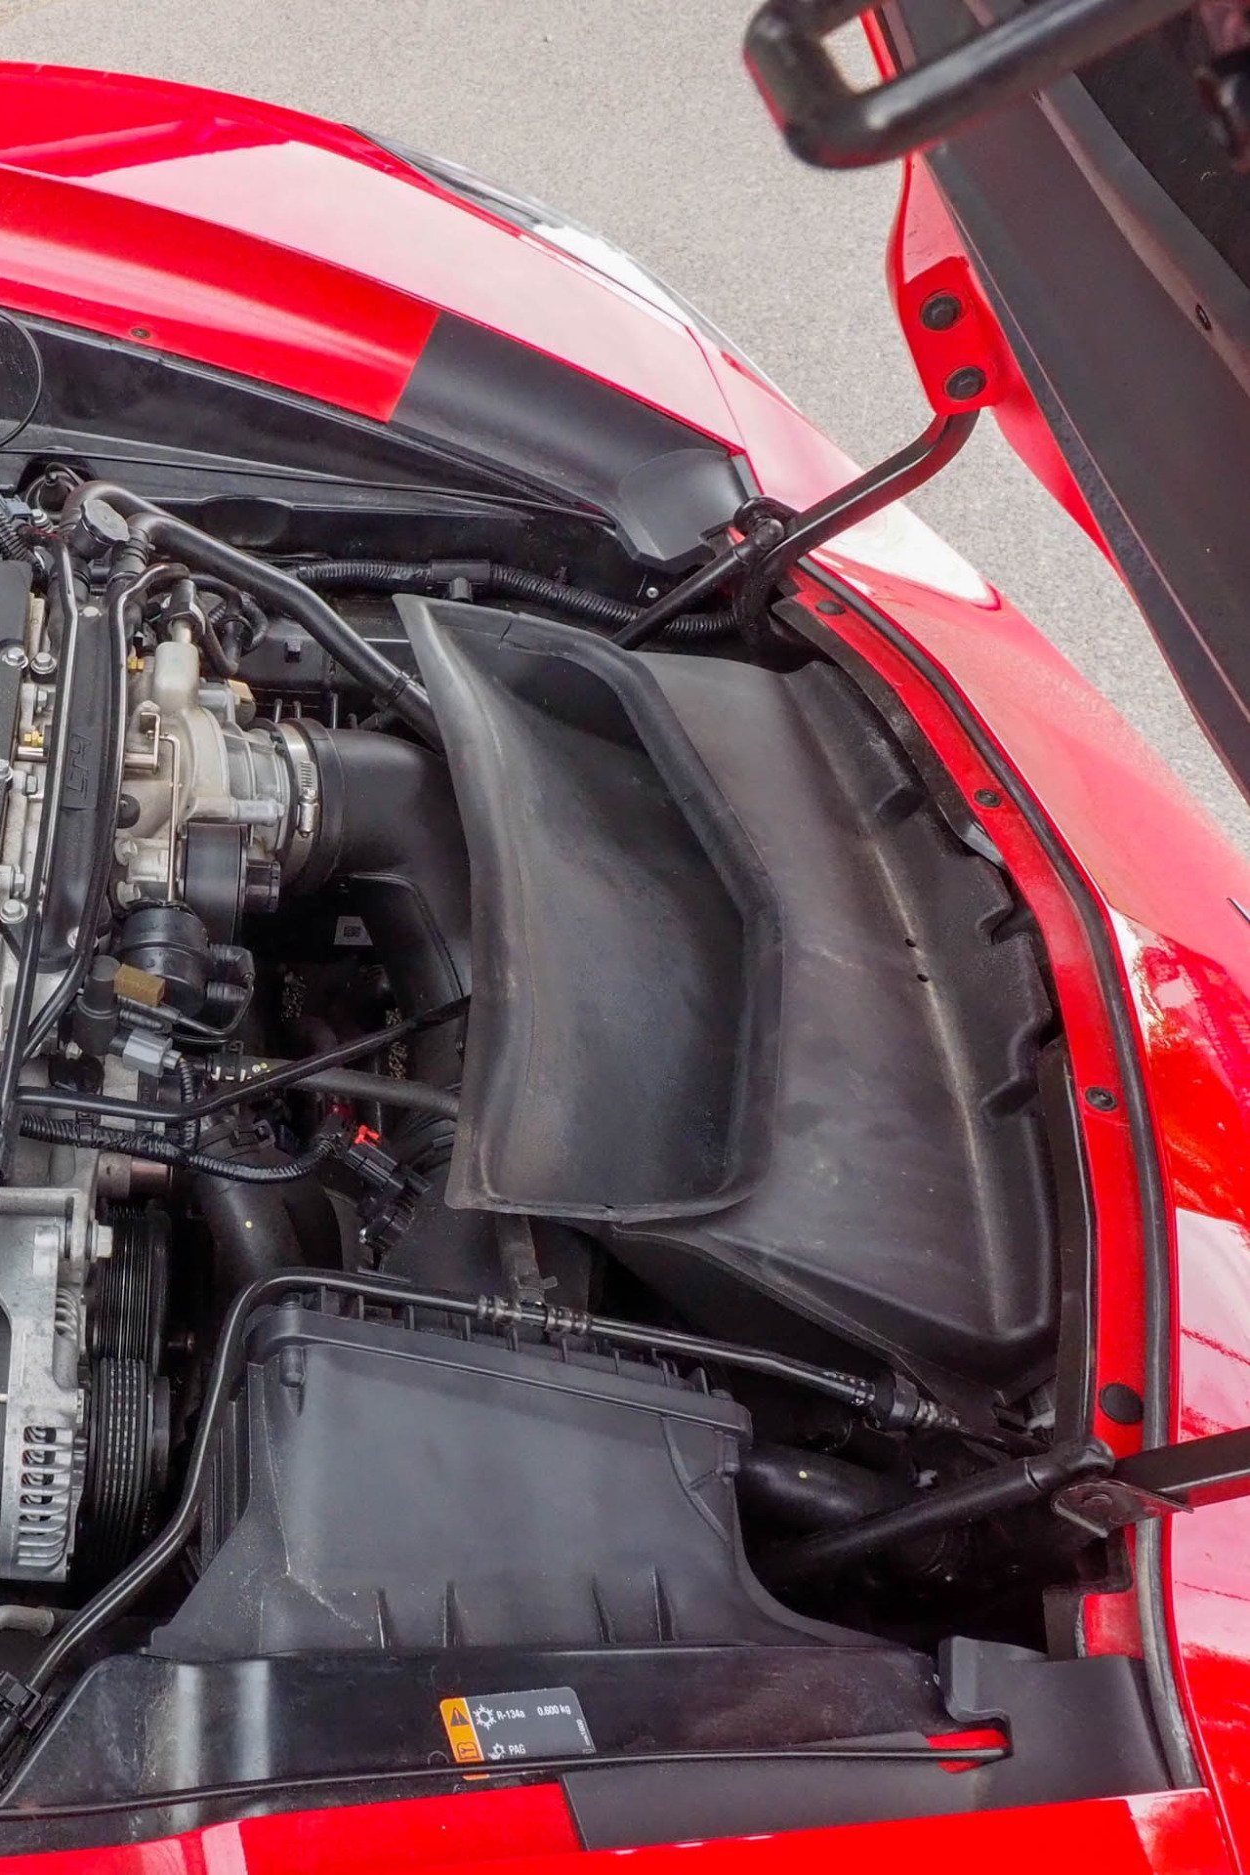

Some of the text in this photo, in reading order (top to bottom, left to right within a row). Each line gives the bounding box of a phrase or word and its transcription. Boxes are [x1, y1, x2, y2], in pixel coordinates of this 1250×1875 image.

[496, 1709, 526, 1720] R-134a
[560, 1704, 572, 1715] kg
[508, 1743, 526, 1756] PAG
